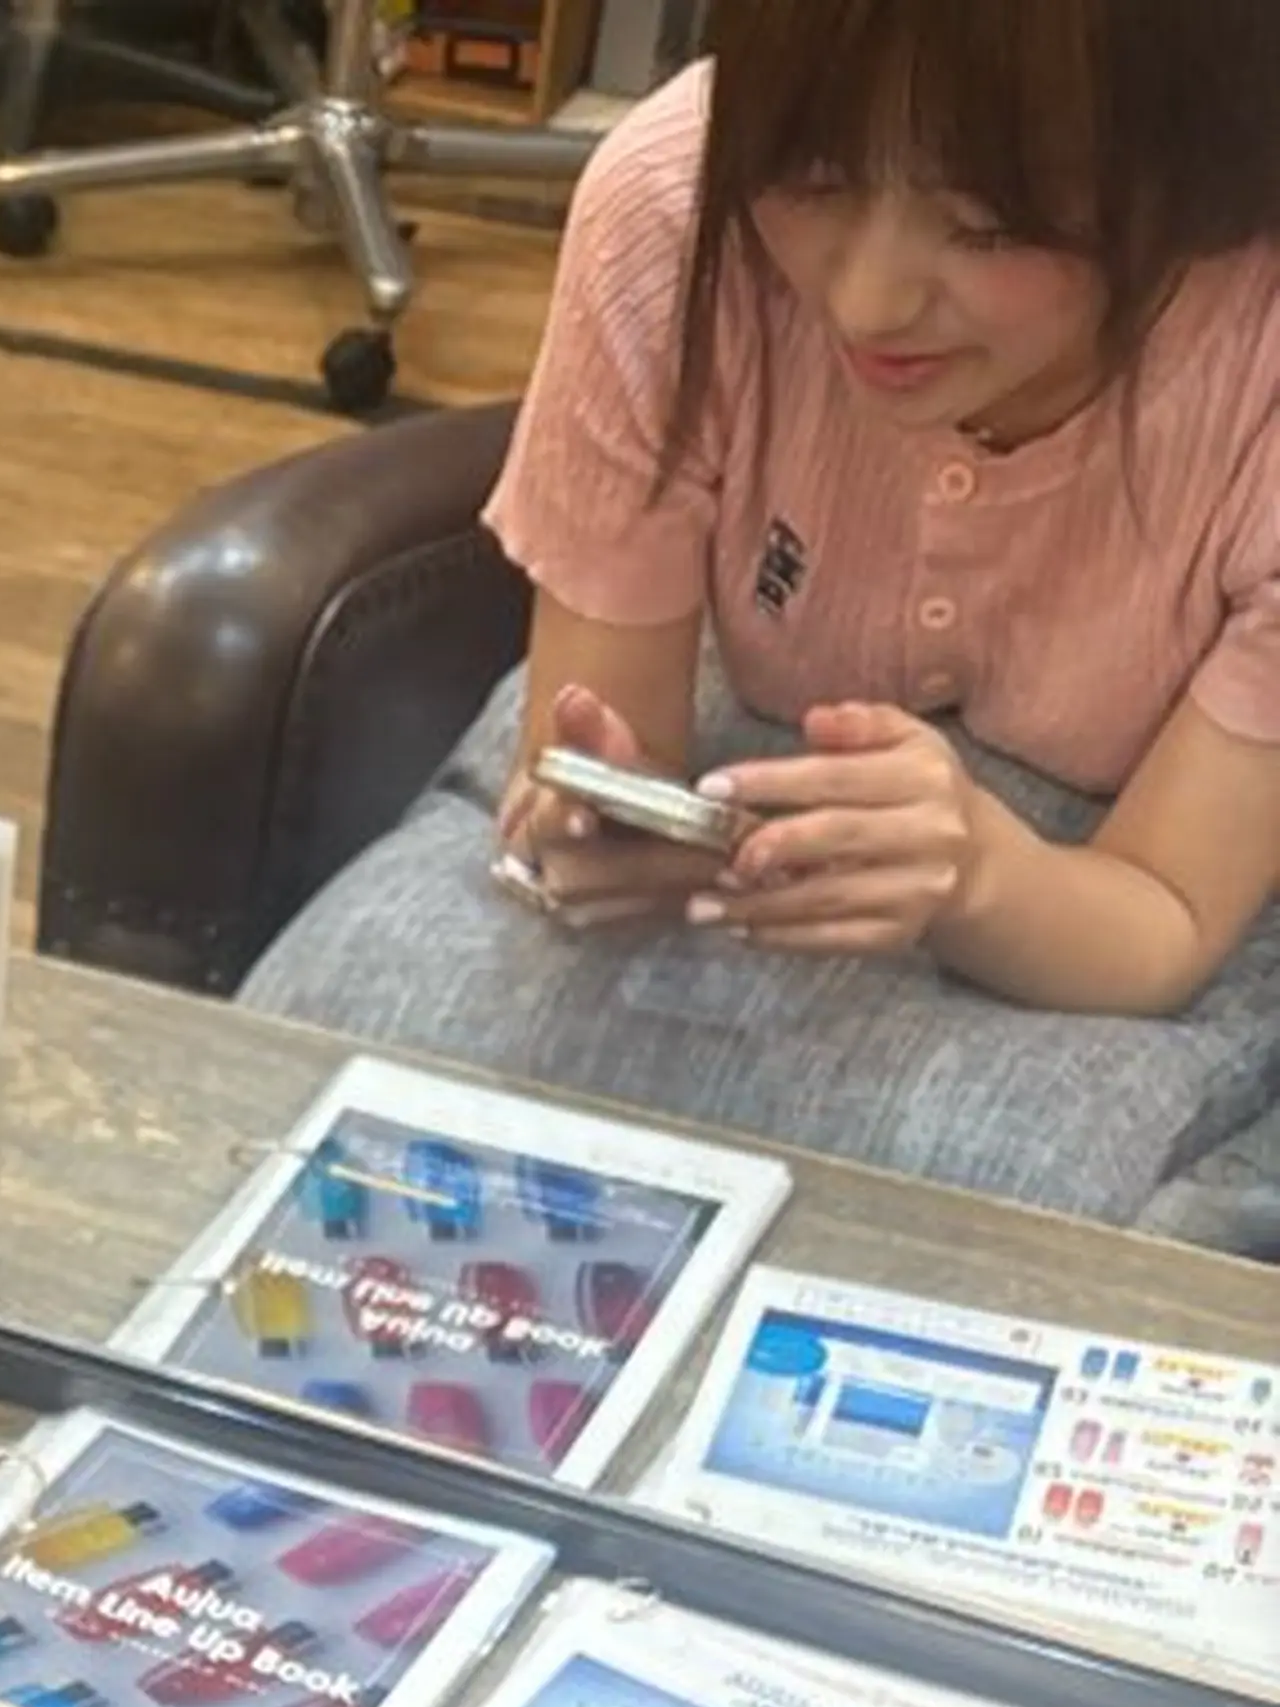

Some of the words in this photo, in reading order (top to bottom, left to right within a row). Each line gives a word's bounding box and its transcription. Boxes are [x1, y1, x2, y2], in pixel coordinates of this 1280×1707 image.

[2, 1553, 91, 1610] Item
[97, 1591, 182, 1638] Line
[188, 1622, 244, 1664] Up
[251, 1644, 359, 1705] Book
[139, 1573, 264, 1632] Aujua
